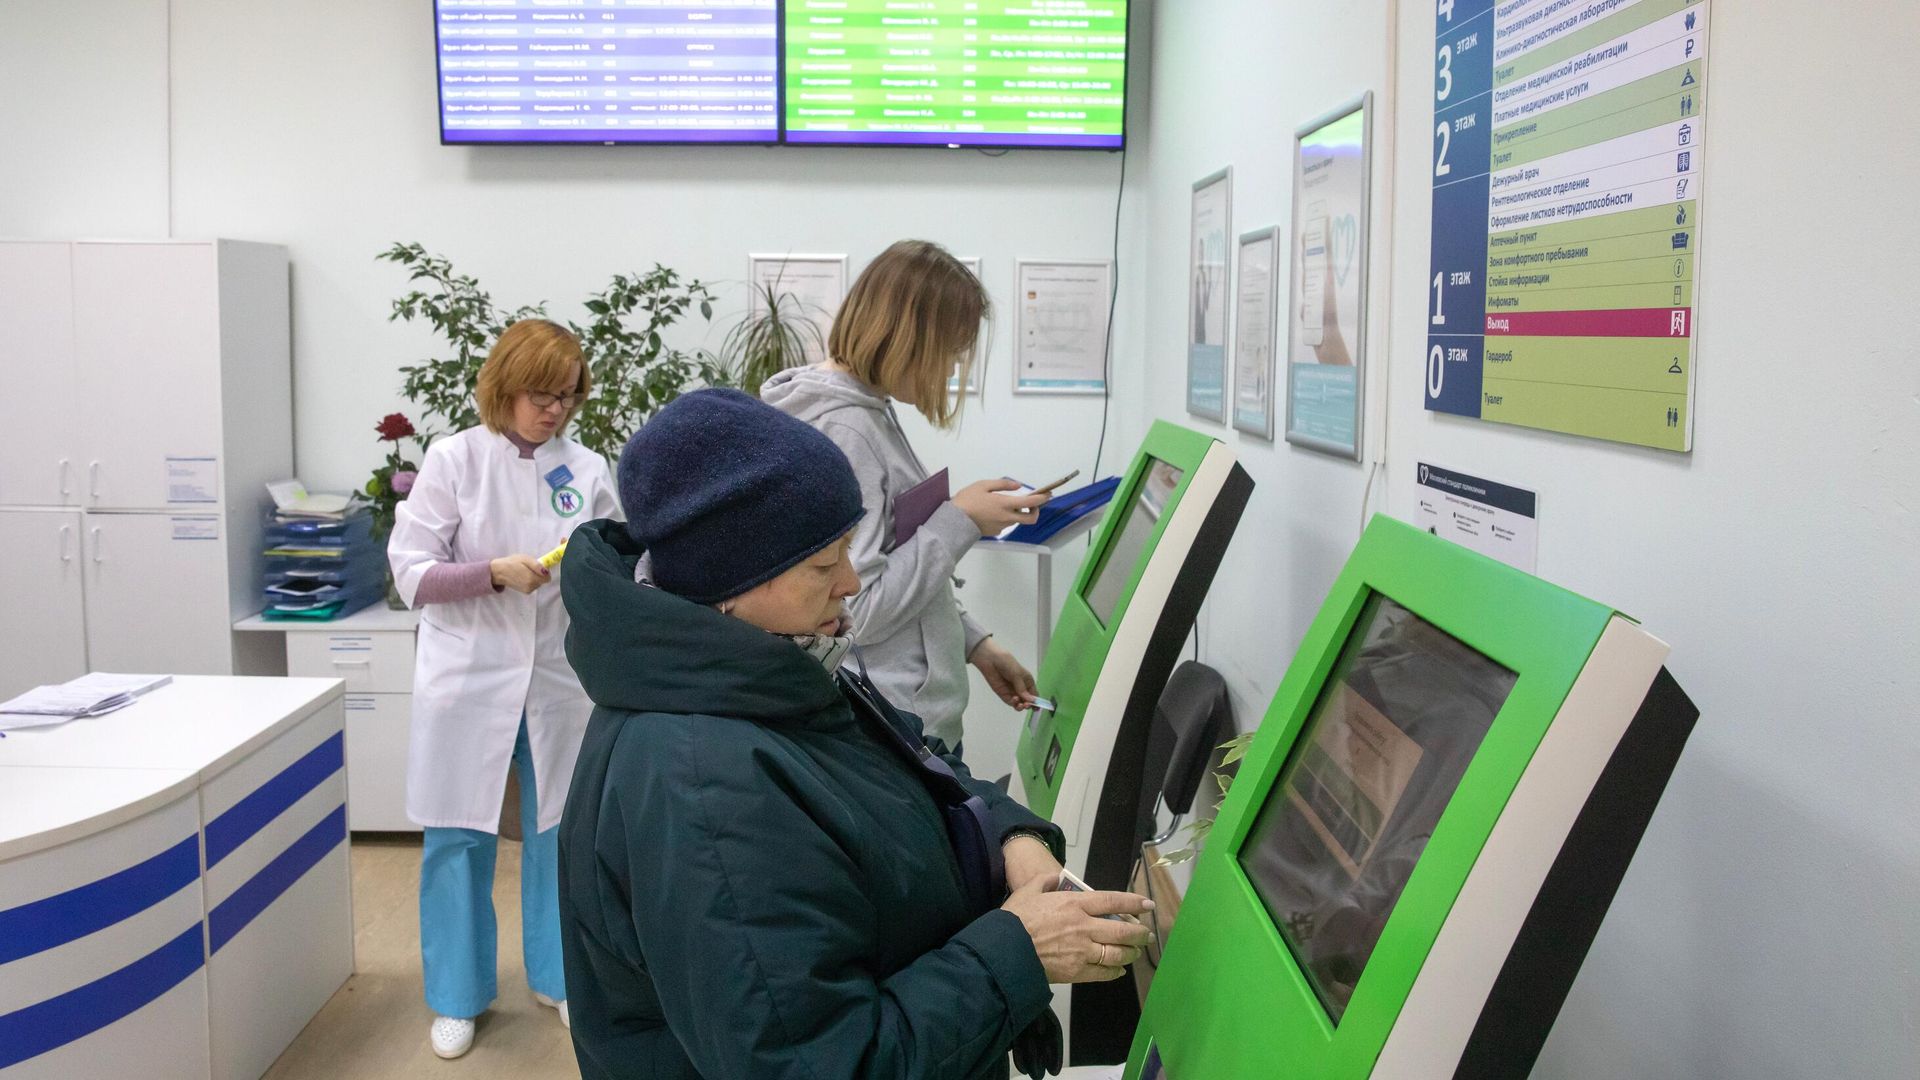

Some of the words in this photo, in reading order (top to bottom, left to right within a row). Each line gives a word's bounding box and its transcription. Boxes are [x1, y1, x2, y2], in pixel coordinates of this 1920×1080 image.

[1496, 9, 1543, 39] Ультразвуковая
[1495, 16, 1578, 60] Клинико-диагностическая
[1437, 45, 1452, 101] 3
[1456, 32, 1478, 55] этаж
[1495, 83, 1527, 103] Отделение
[1528, 60, 1573, 89] медицинской
[1573, 41, 1628, 74] реабилитации
[1494, 107, 1520, 123] Платные
[1520, 91, 1565, 113] медицинские
[1566, 81, 1589, 103] услуги
[1435, 121, 1450, 177] 2
[1454, 113, 1476, 133] этаж
[1493, 123, 1537, 145] Прикрепление
[1493, 152, 1512, 165] Туалет
[1492, 169, 1524, 189] Дежурный
[1525, 168, 1540, 182] врач
[1491, 185, 1552, 207] Рентгенологическое
[1553, 177, 1590, 195] отделение
[1491, 211, 1529, 228] Оформление
[1530, 206, 1556, 221] листков
[1556, 192, 1633, 217] нетрудоспособности
[1490, 232, 1519, 247] Аптечный
[1519, 232, 1538, 245] пункт
[1489, 256, 1503, 268] Зона
[1504, 252, 1544, 267] комфортного
[1545, 247, 1589, 263] пребывания
[1488, 275, 1508, 288] Стойка
[1509, 273, 1550, 288] информации
[1432, 271, 1446, 325] 1
[1450, 271, 1471, 286] этаж
[1487, 295, 1519, 309] Инфоматы
[1487, 316, 1510, 332] Выход
[1485, 349, 1513, 363] Гардероб
[1428, 344, 1444, 399] 0
[1447, 348, 1468, 362] этаж
[1484, 392, 1503, 406] Туалет
